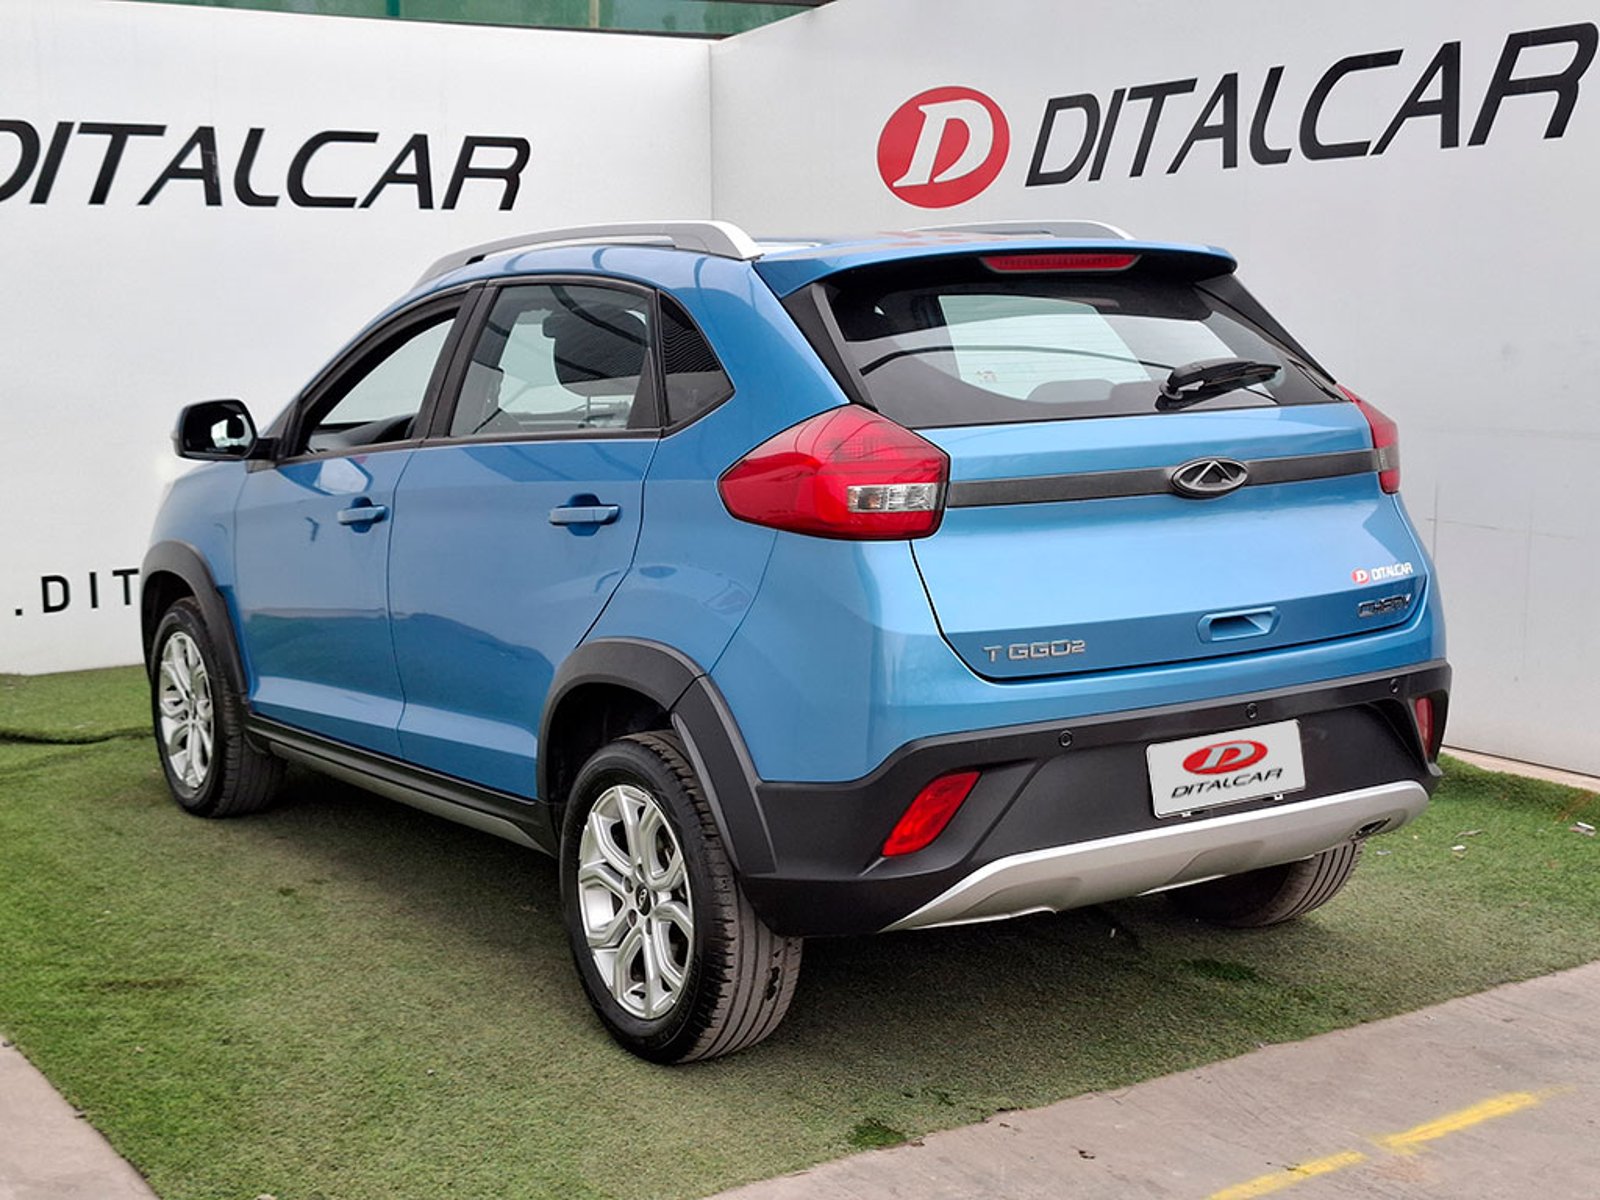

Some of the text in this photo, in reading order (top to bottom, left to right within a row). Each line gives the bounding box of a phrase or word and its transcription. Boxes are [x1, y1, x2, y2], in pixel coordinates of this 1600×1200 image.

[1025, 22, 1599, 188] DITALCAR
[0, 119, 531, 210] DITALCAR
[1371, 562, 1413, 581] DITALCAR
[1171, 767, 1283, 799] DITALCAR
